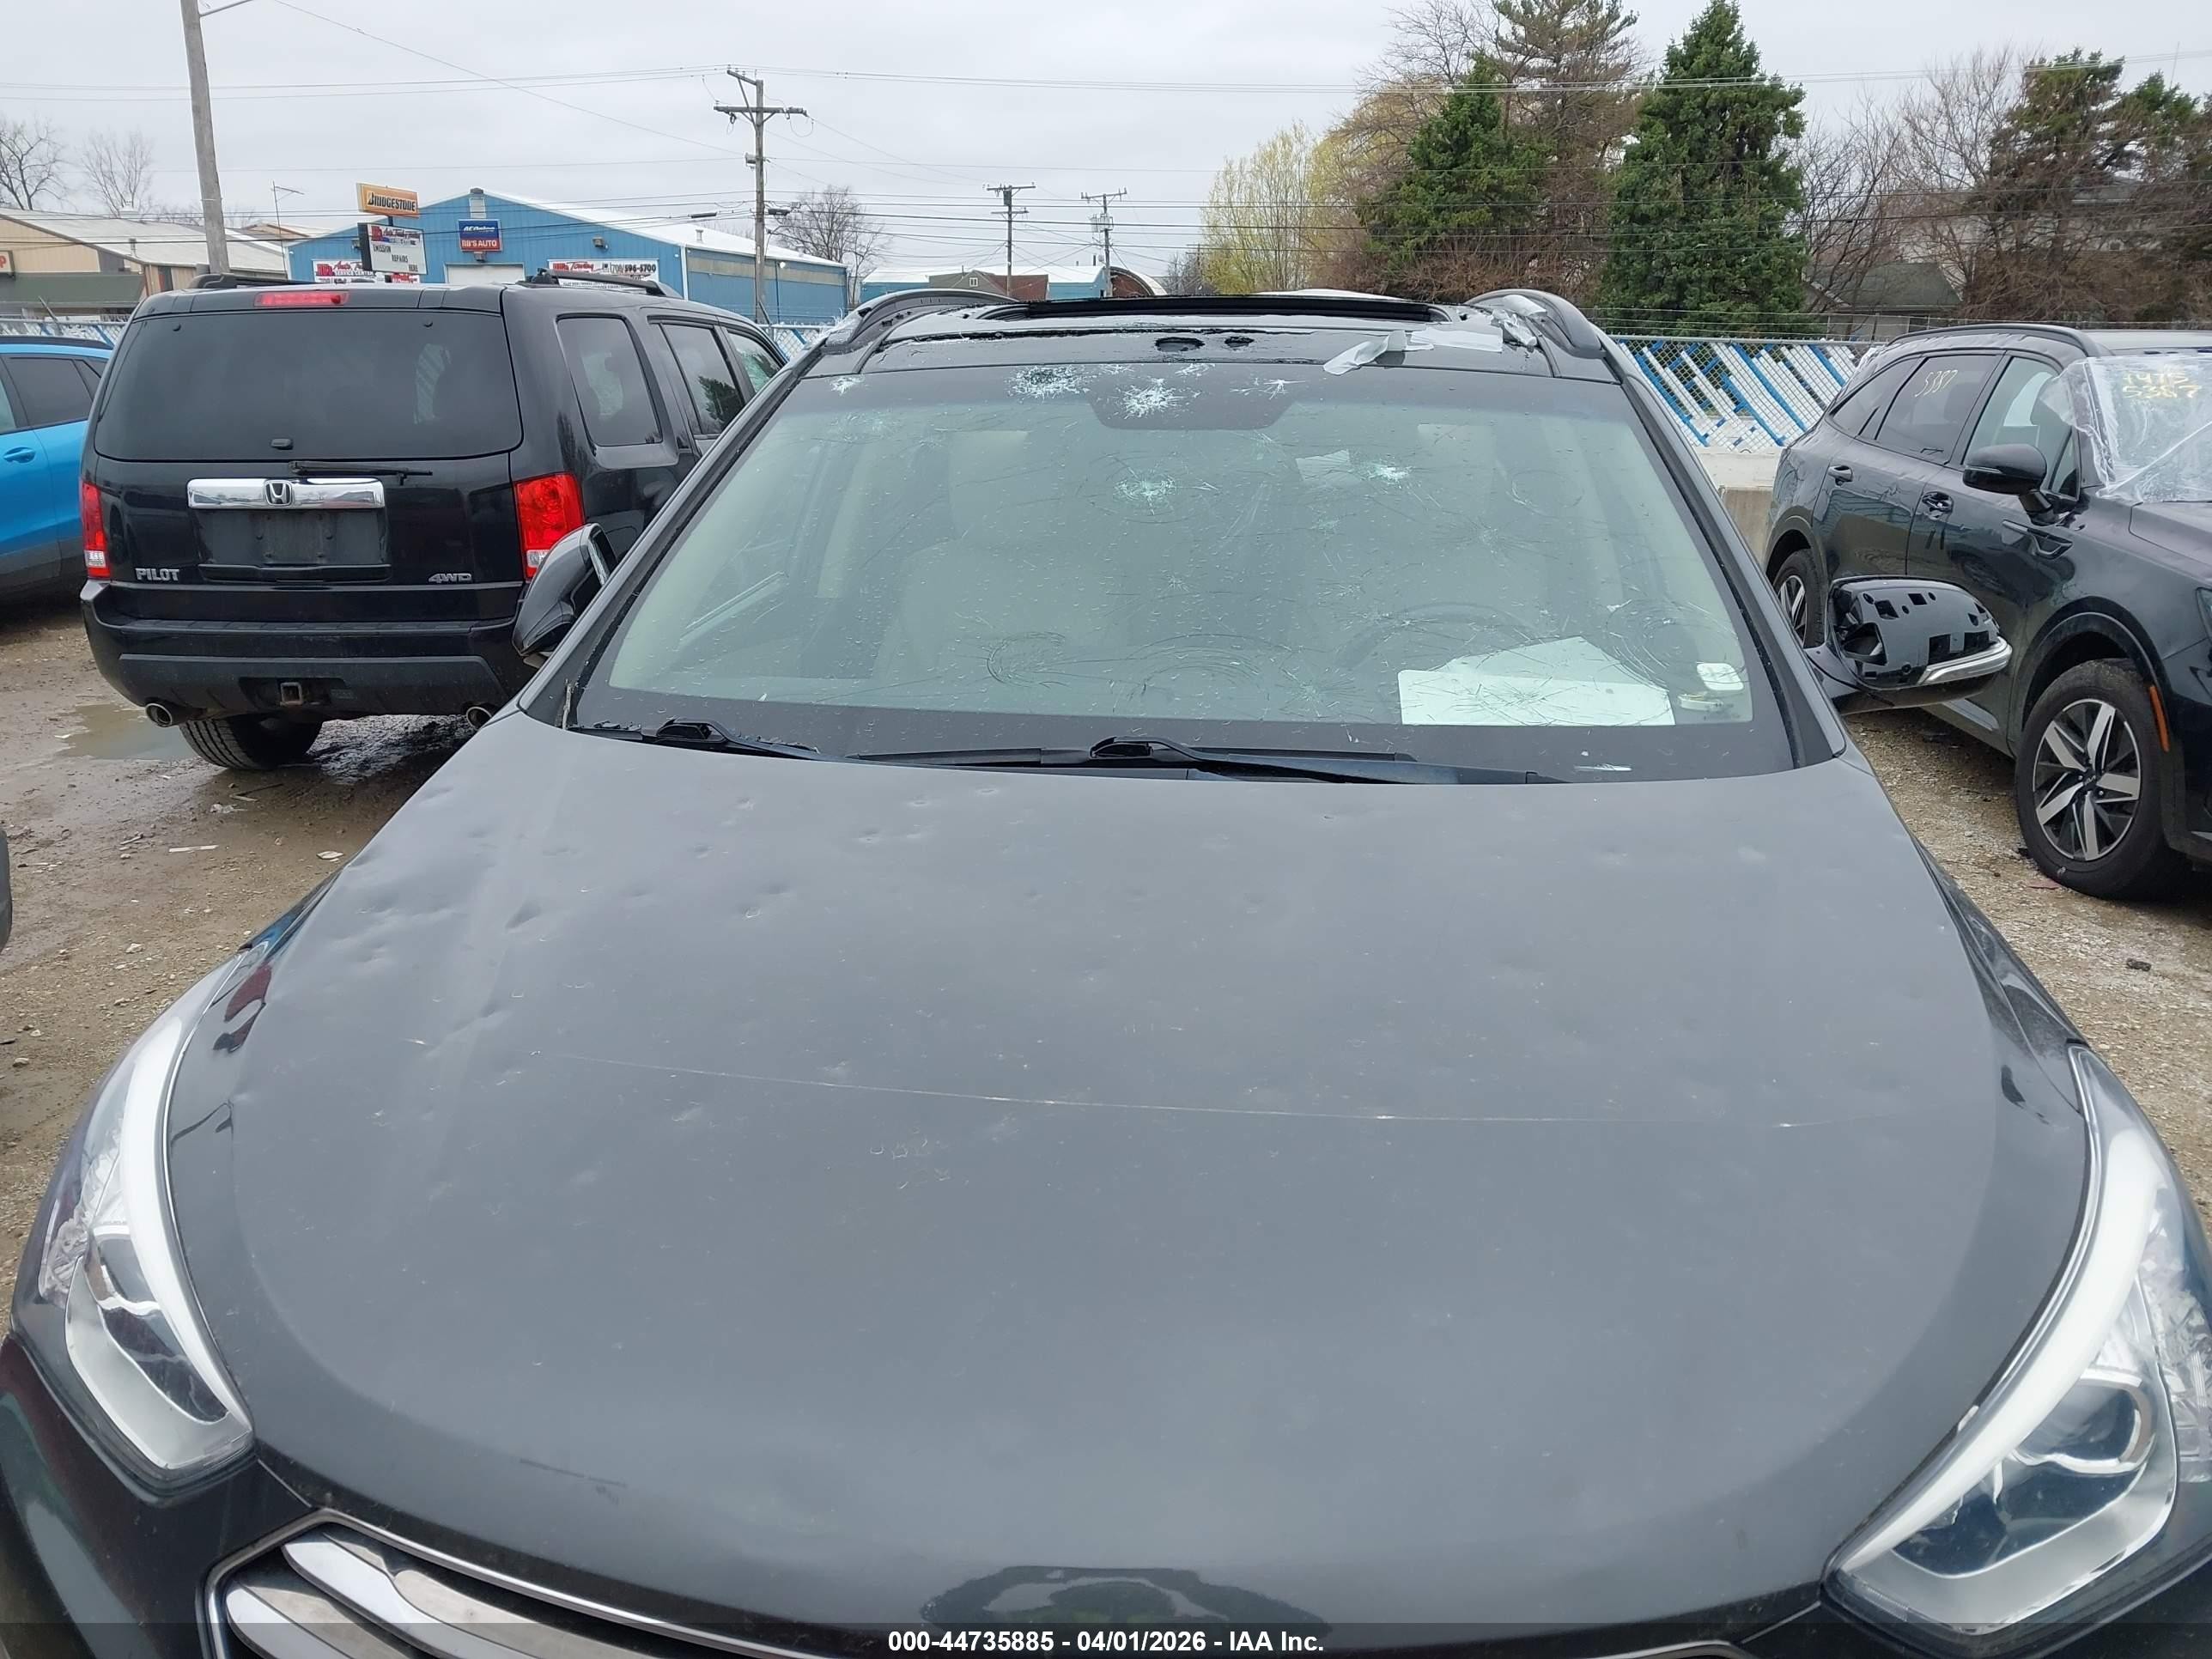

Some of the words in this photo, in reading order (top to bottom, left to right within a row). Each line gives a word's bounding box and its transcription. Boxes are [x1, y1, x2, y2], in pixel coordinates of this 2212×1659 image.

[368, 191, 416, 211] BRIDGESTONE
[392, 253, 409, 263] REPAIRS
[1915, 369, 1958, 397] 5387
[135, 568, 179, 581] PILOT
[428, 573, 472, 583] 4WD
